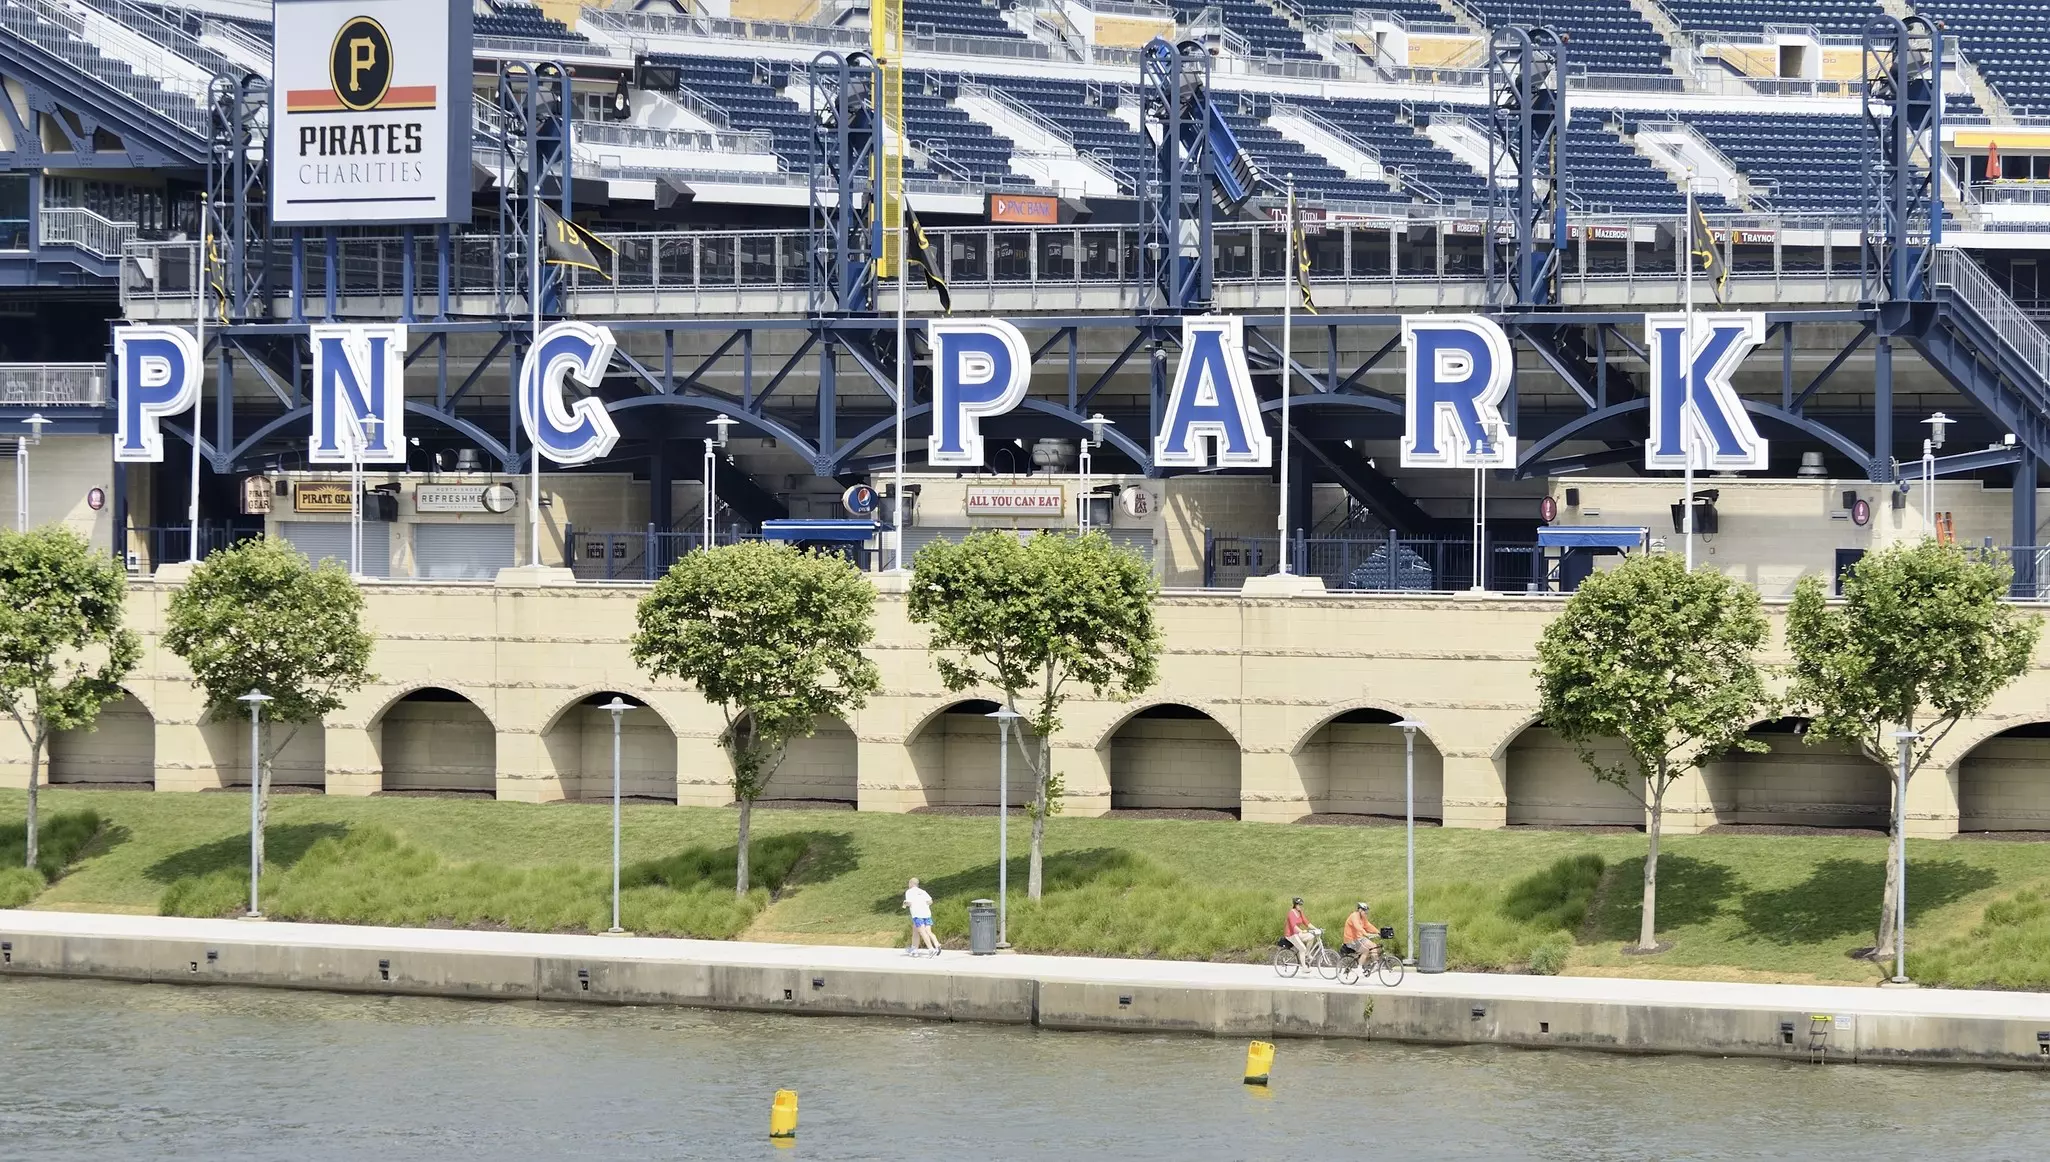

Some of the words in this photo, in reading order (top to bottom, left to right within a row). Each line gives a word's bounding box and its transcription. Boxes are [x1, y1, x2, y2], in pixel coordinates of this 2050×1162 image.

[349, 36, 376, 92] P
[299, 123, 422, 156] PIRATES
[299, 161, 422, 185] CHARITIES
[1007, 200, 1025, 215] PNC
[1027, 201, 1050, 216] BANK
[1587, 227, 1593, 239] 9
[114, 321, 620, 465] PNC
[928, 312, 1768, 470] PARK
[248, 500, 270, 509] GEAR
[302, 494, 333, 504] PIRATE
[335, 494, 359, 504] GEA
[421, 494, 482, 503] REFRESHME
[969, 496, 989, 506] ALL
[991, 496, 1012, 506] YOU
[1014, 496, 1035, 506] CAN
[1038, 496, 1060, 507] EAT
